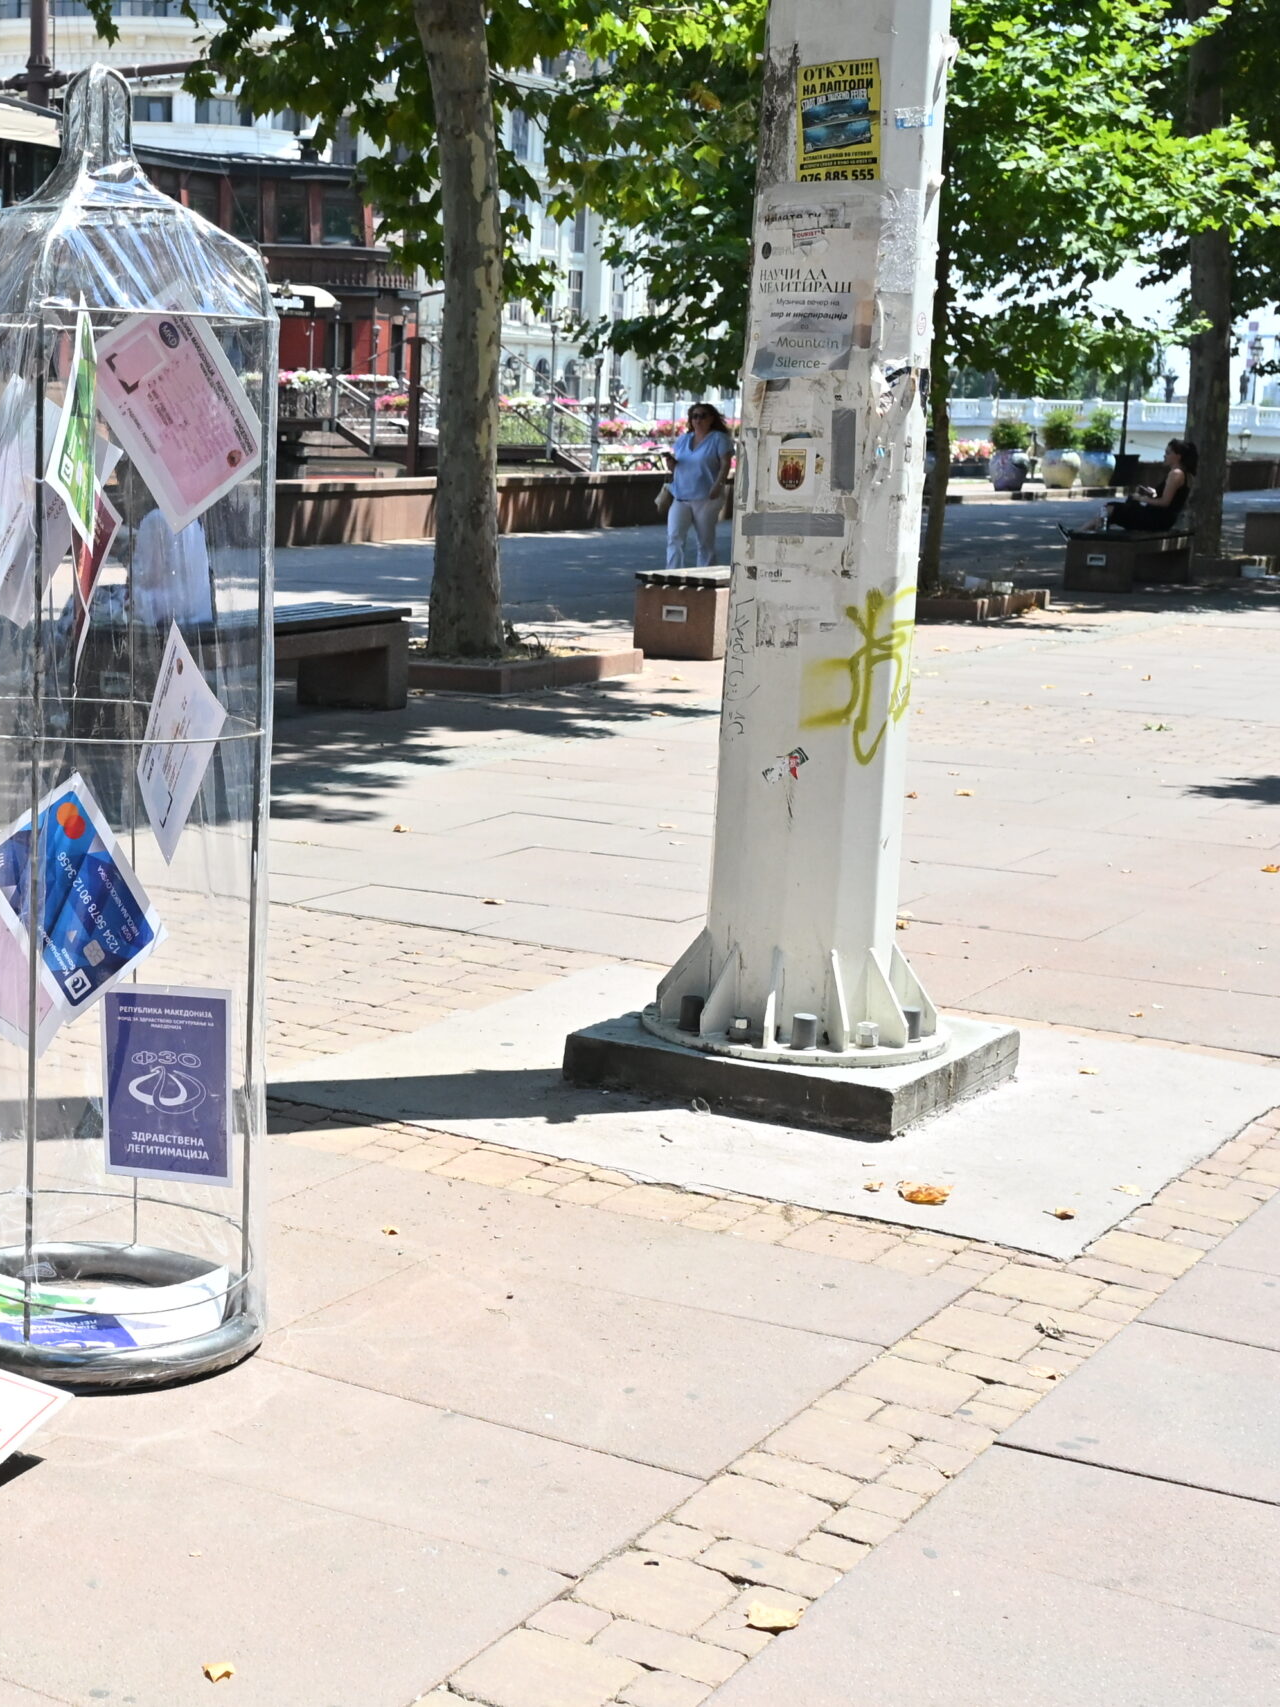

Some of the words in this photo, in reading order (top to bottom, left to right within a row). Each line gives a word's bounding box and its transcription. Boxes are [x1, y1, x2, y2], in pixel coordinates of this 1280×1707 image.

[803, 62, 873, 81] ОТКУП!!!
[802, 84, 817, 96] НА
[819, 78, 874, 94] ЛАПТОПИ
[800, 173, 821, 182] 076
[824, 171, 848, 181] 885
[851, 168, 875, 180] 555
[760, 268, 800, 281] НАУЧИ
[804, 268, 827, 281] ДА
[759, 281, 852, 294] МЕДИТИРАШ
[161, 324, 178, 346] MKD
[57, 851, 77, 879] 3456
[73, 877, 92, 905] 9012
[88, 903, 107, 930] 5678
[103, 929, 121, 954] 1234
[119, 1005, 163, 1015] РЕПУБЛИКА
[164, 1008, 213, 1019] МАКЕДОНИЈА
[131, 1050, 202, 1068] ФЗО
[131, 1131, 205, 1147] ЗДРАВСТВЕНА
[127, 1143, 210, 1161] ЛЕГИТИМАЦИЈА
